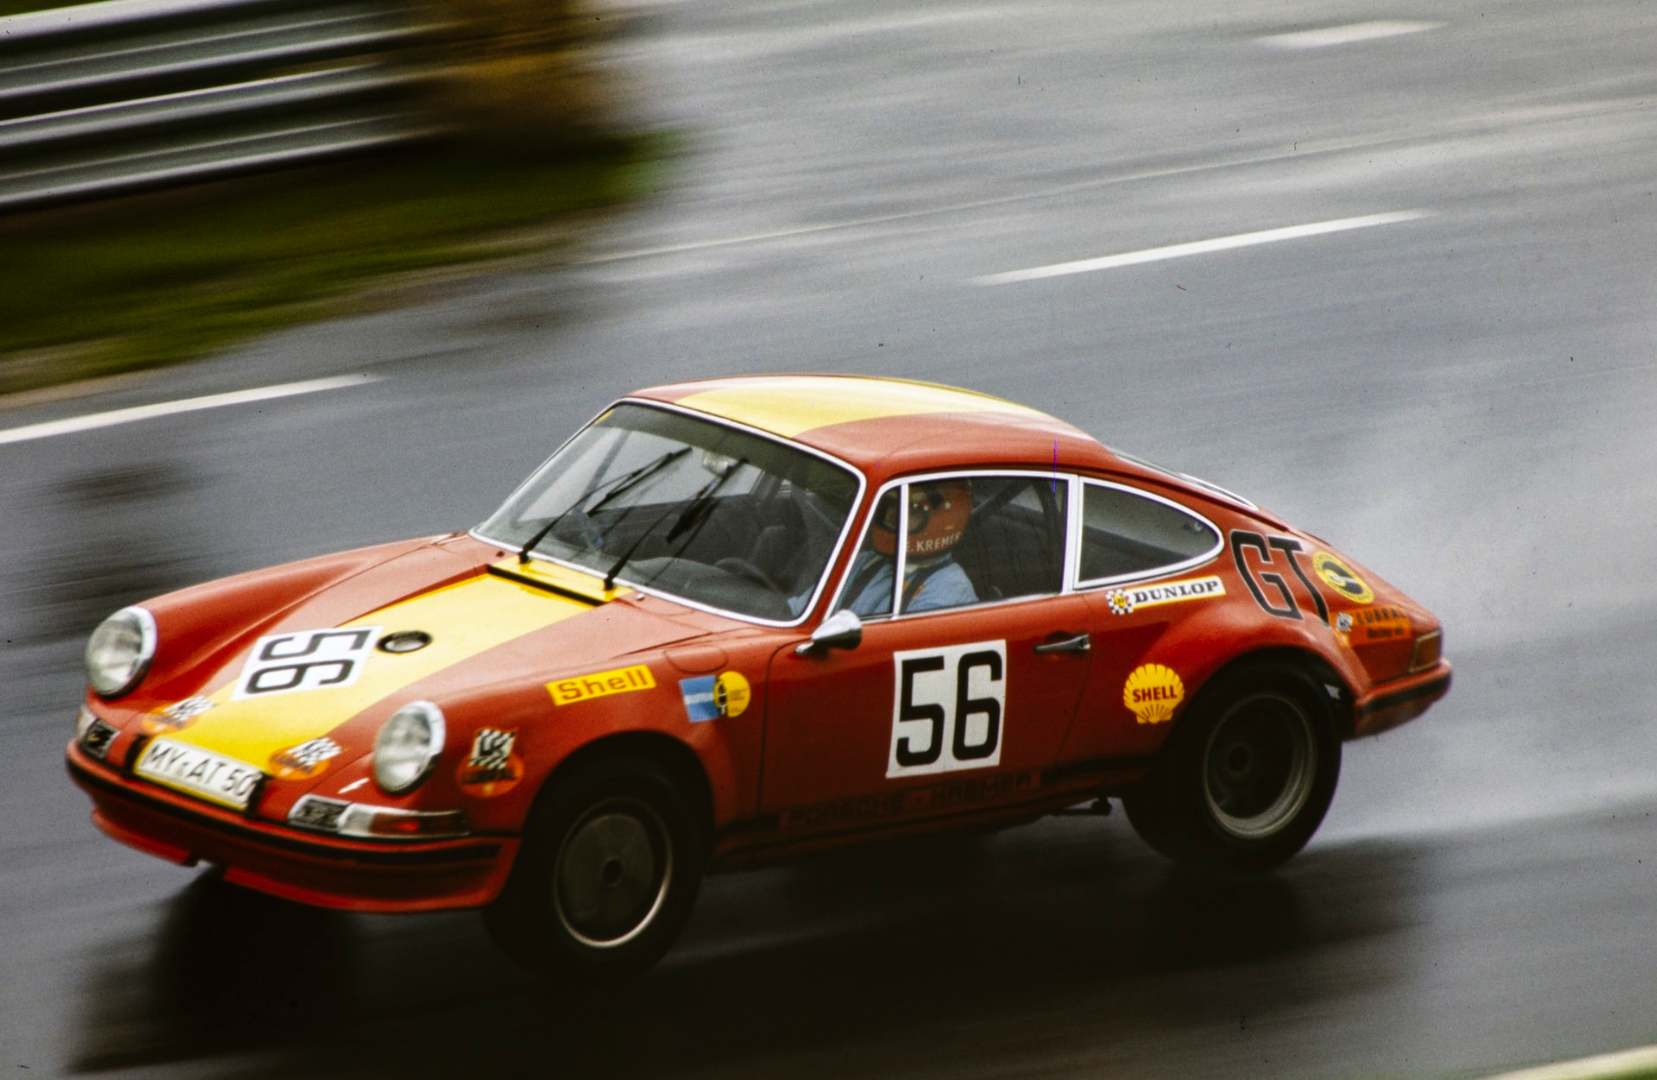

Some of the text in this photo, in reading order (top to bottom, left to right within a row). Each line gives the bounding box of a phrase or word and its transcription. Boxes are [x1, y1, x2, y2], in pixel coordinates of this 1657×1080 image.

[1134, 580, 1218, 603] DUNLOP
[1230, 529, 1329, 627] GT
[245, 629, 373, 695] 56
[557, 668, 648, 701] Shell
[1132, 684, 1178, 702] SHELL
[896, 650, 1003, 767] 56
[930, 773, 1033, 803] KREMER
